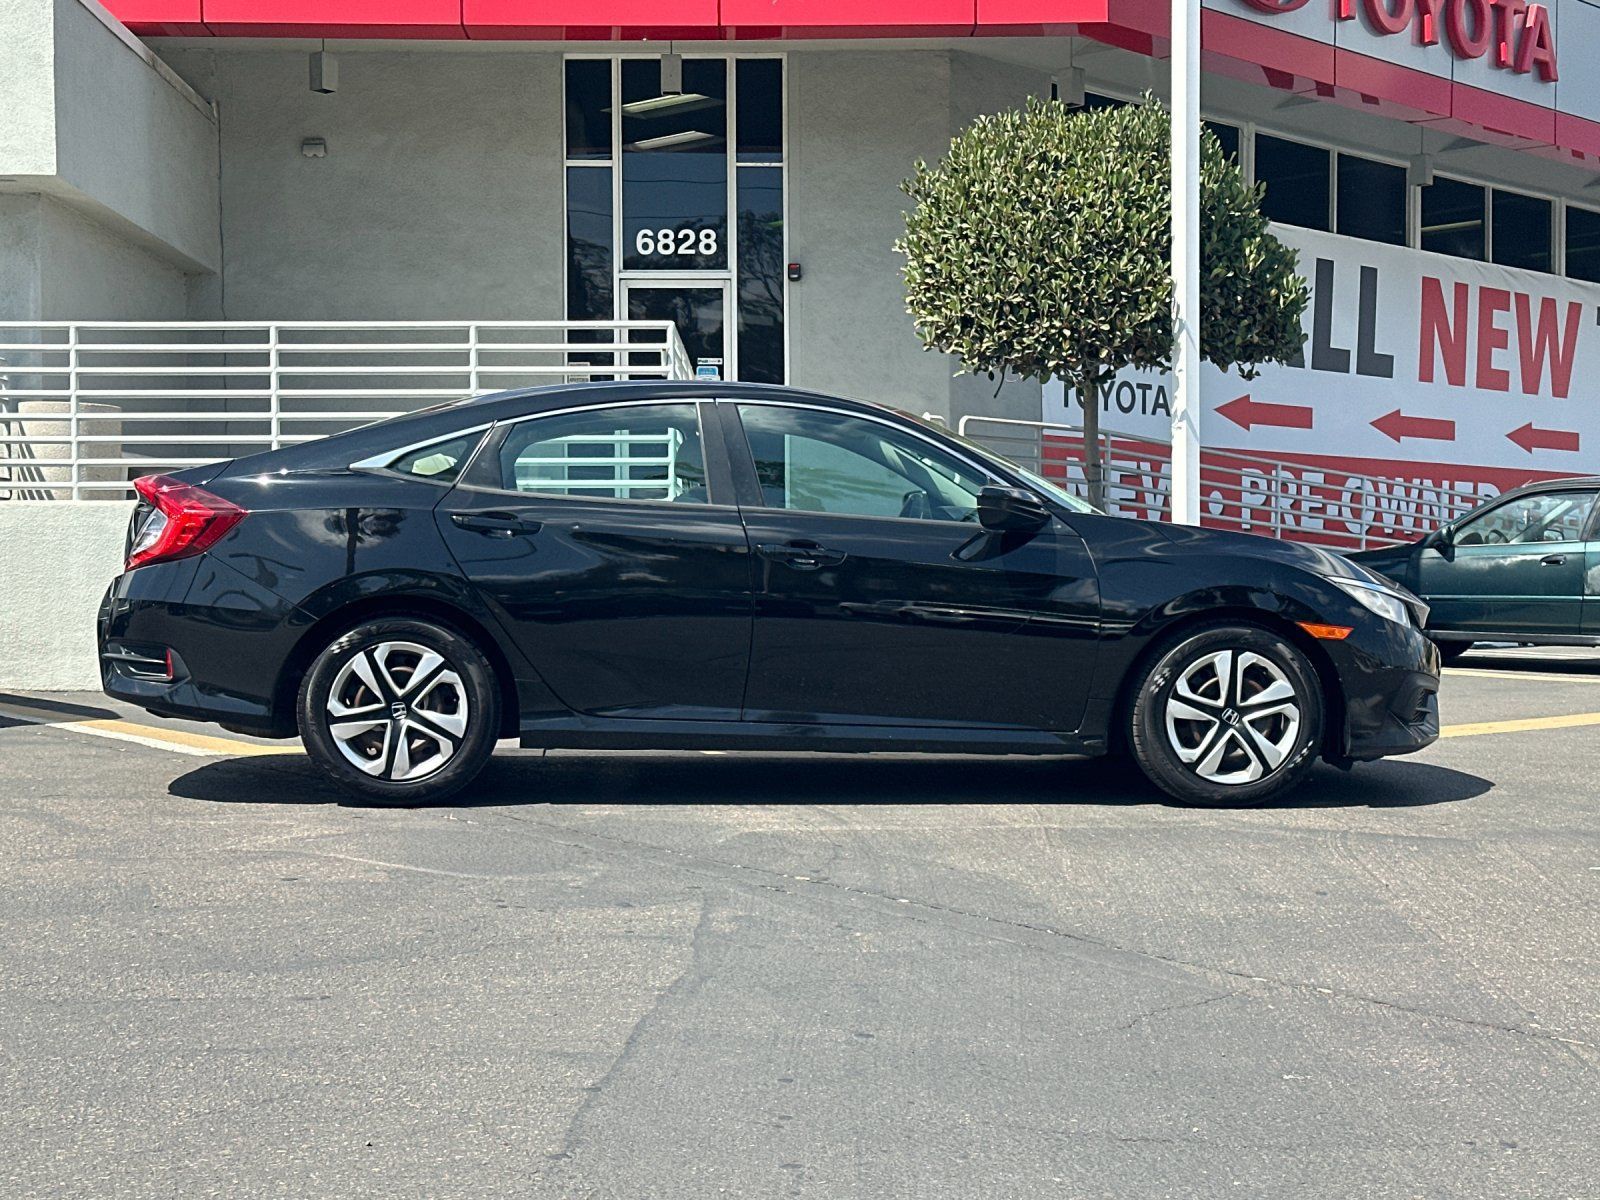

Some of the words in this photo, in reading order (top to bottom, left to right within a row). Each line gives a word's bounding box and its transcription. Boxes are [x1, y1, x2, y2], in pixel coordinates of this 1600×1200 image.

[1338, 0, 1559, 82] YOTA
[636, 228, 718, 256] 6828
[1286, 257, 1395, 378] LL
[1418, 276, 1583, 398] NEW
